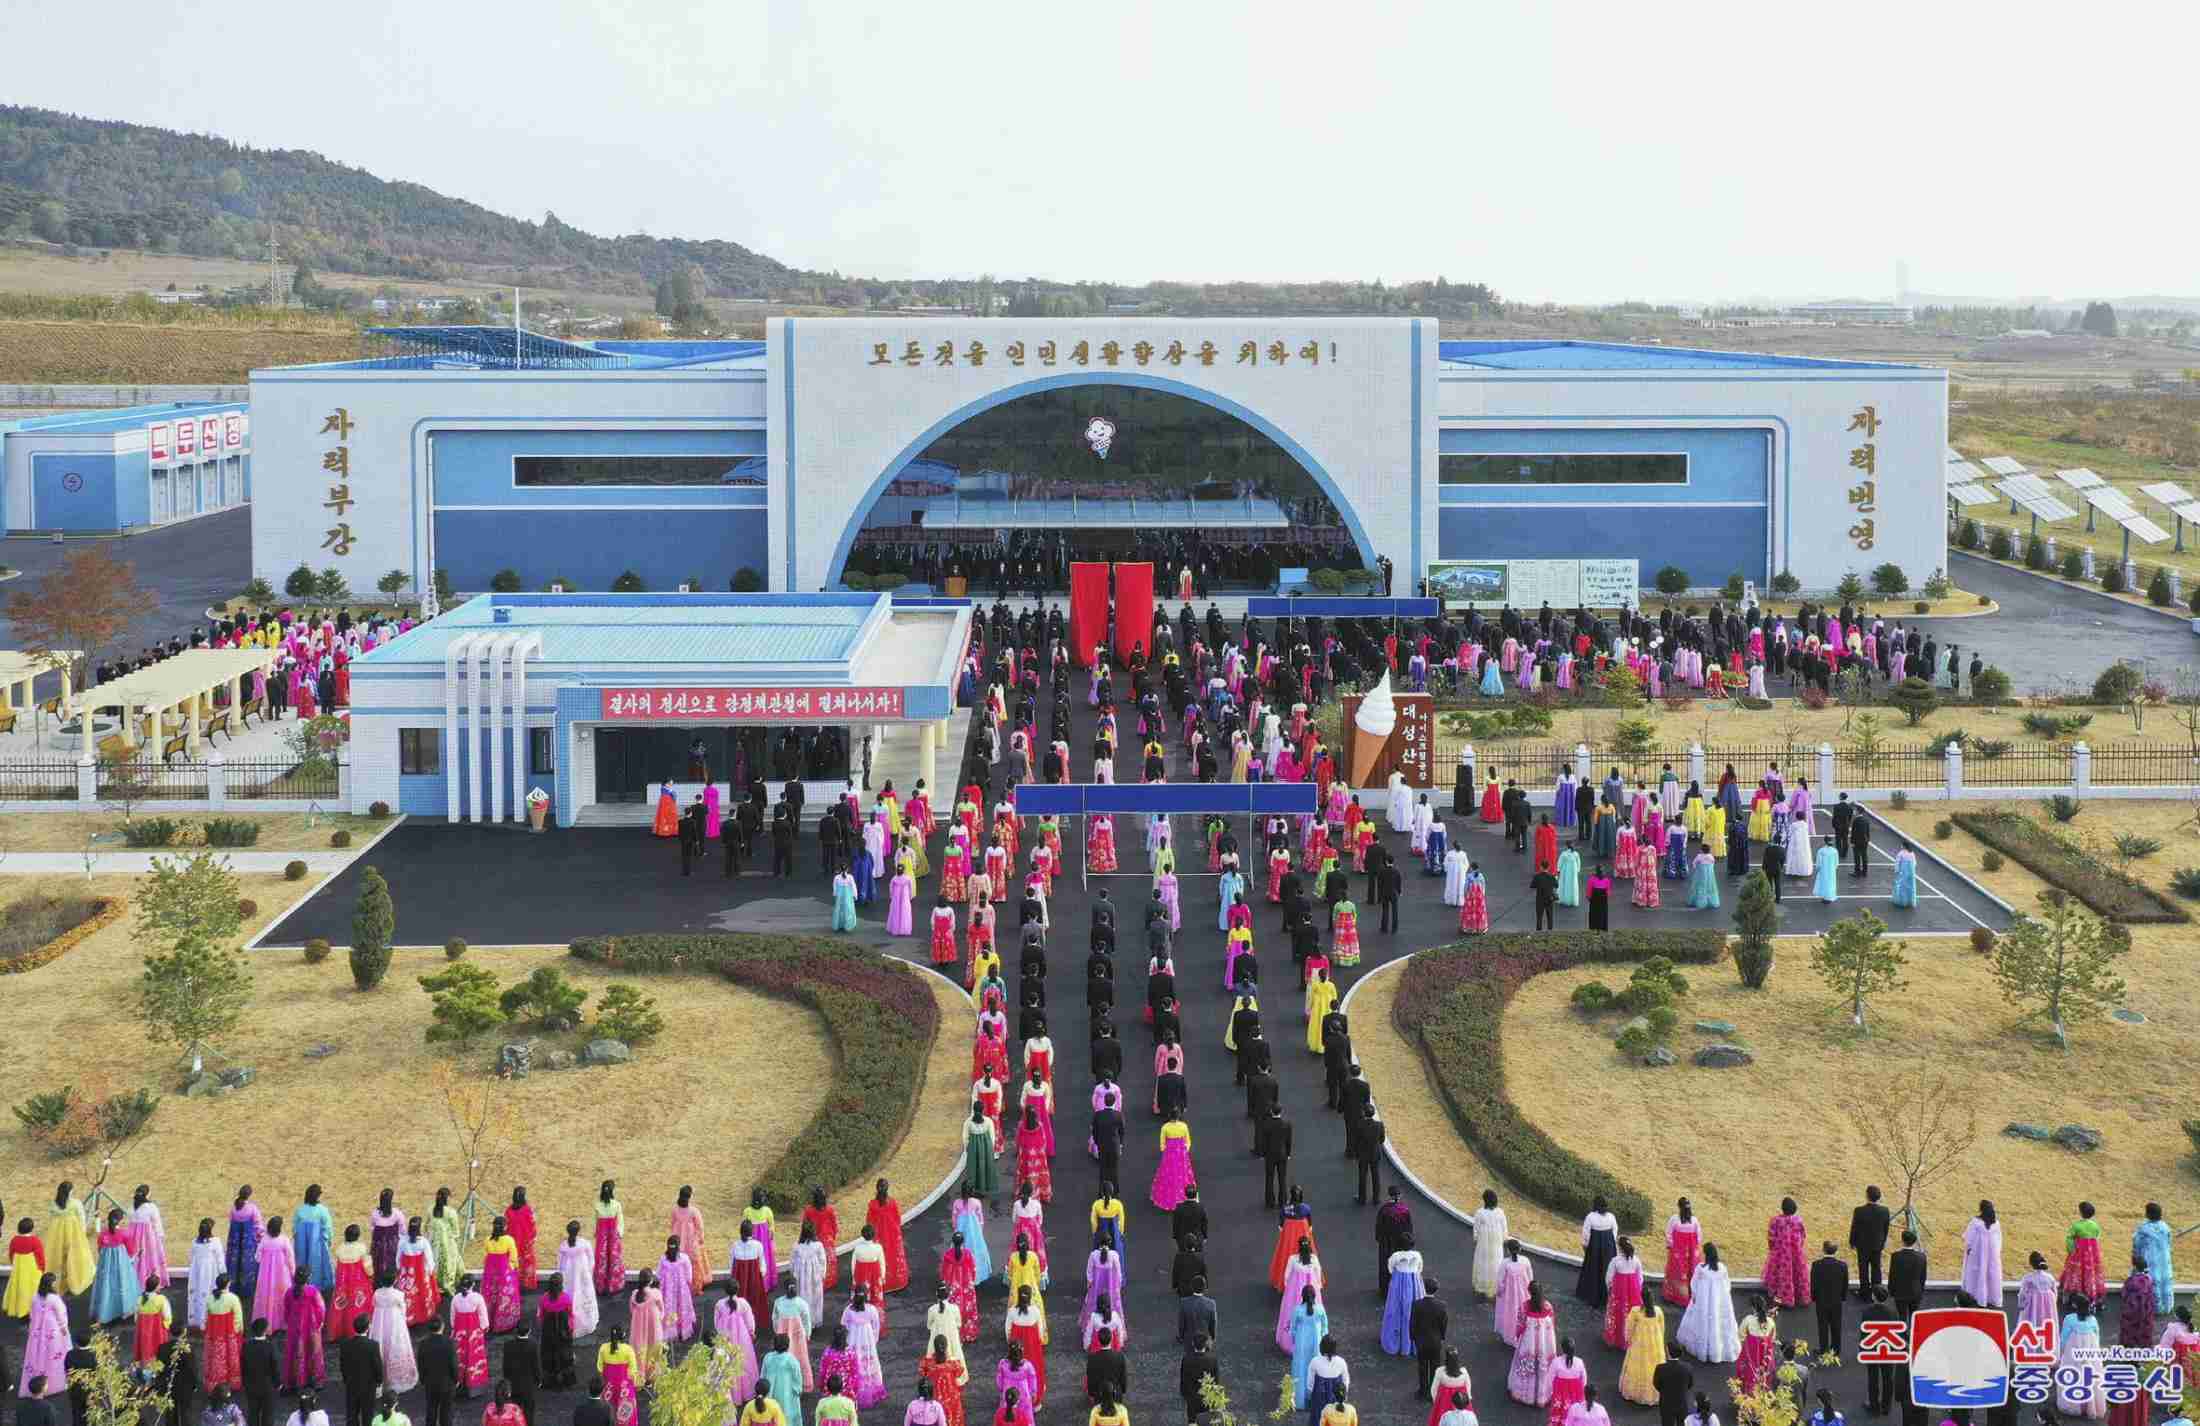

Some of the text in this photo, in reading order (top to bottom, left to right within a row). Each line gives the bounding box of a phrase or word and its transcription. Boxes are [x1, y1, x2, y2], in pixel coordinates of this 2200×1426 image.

[867, 340, 1337, 367] 모든것을 인민생활향상을 위하여!
[320, 407, 357, 556] 자력부강
[1846, 406, 1882, 550] 자력번영
[609, 692, 652, 714] 결사의
[657, 692, 718, 714] 정신으로
[725, 692, 810, 714] 당정책관철에
[1402, 703, 1418, 764] 대성산
